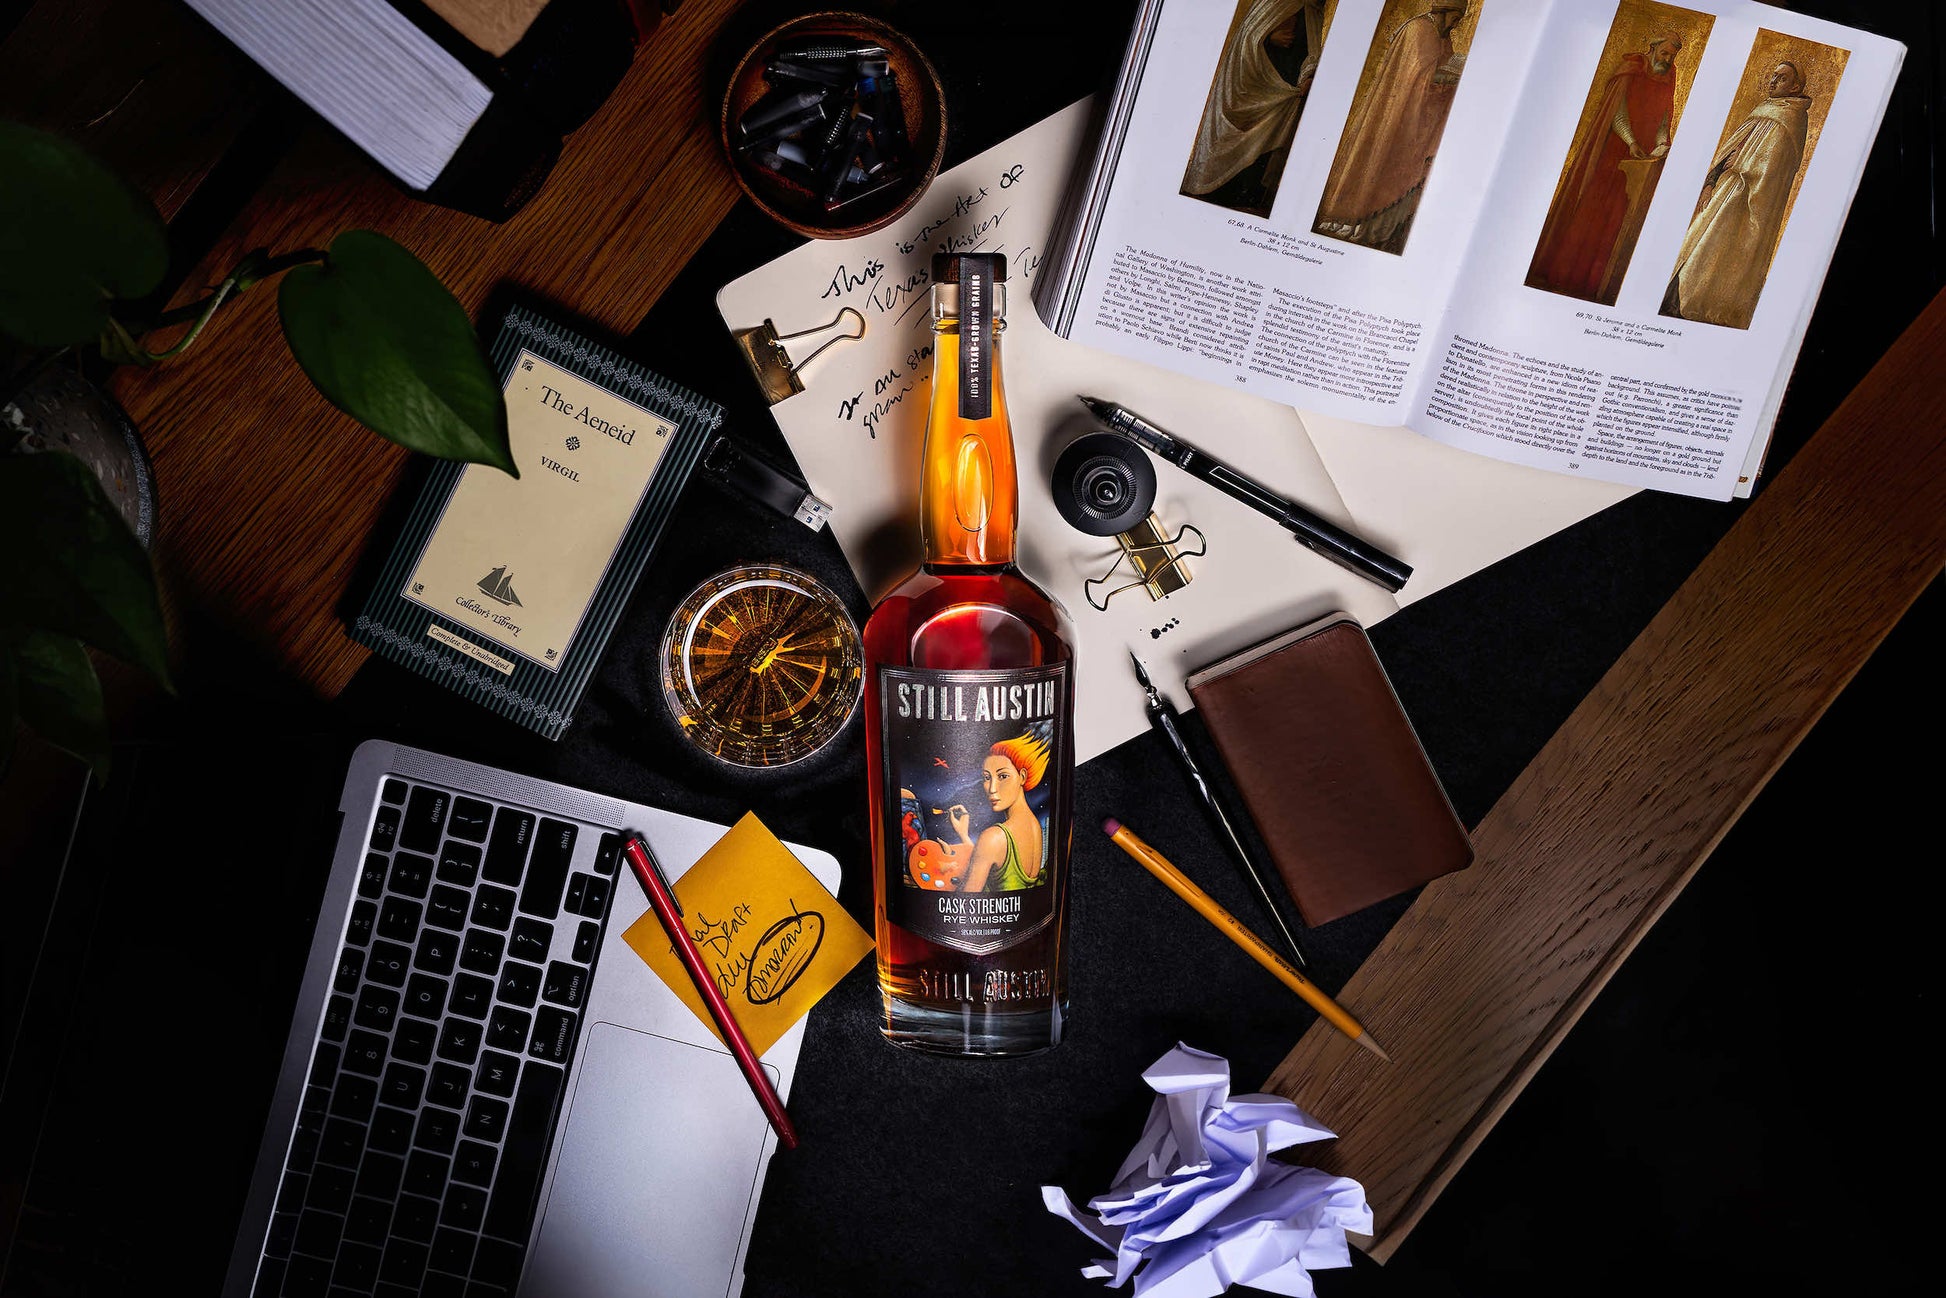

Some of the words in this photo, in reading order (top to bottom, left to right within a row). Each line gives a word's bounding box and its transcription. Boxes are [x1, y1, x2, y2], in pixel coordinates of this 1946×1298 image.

[896, 242, 914, 256] is
[1254, 226, 1280, 238] Carmelite
[1281, 234, 1296, 243] Monk
[1318, 244, 1345, 256] Augustine
[1115, 250, 1125, 258] nal
[1127, 254, 1148, 266] Gallery
[1159, 263, 1197, 279] Washington,
[1205, 278, 1229, 288] another
[1231, 285, 1247, 293] work
[1126, 245, 1137, 253] The
[1139, 249, 1168, 262] Madonna
[1179, 260, 1207, 274] Humility,
[1246, 280, 1265, 289] Natio-
[865, 268, 929, 312] Texas
[971, 274, 980, 307] GRAINS
[1112, 258, 1130, 268] buted
[1139, 265, 1166, 278] Masaccio
[1167, 273, 1175, 283] by
[1176, 276, 1207, 291] Berenson,
[1208, 285, 1234, 298] followed
[1235, 294, 1261, 307] amongst
[1378, 315, 1391, 324] Pisa
[1603, 317, 1623, 325] Jerome
[1641, 324, 1666, 334] Carmelite
[971, 312, 980, 373] TEXAS-GROWN
[1261, 325, 1274, 334] The
[1273, 330, 1307, 344] connection
[1325, 345, 1356, 357] polyptych
[1382, 357, 1410, 367] Florentine
[1453, 334, 1478, 347] throned
[1512, 352, 1524, 360] The
[1525, 357, 1546, 366] echoes
[1570, 367, 1586, 375] study
[1235, 375, 1246, 383] 388
[1465, 347, 1478, 356] and
[1477, 352, 1520, 369] contemporary
[1520, 364, 1548, 376] sculpture,
[1549, 370, 1564, 378] from
[1564, 373, 1582, 382] Nicola
[1582, 376, 1601, 385] Pisano
[970, 378, 979, 398] 100%
[540, 385, 573, 415] The
[574, 406, 636, 446] Aeneid
[1622, 417, 1641, 427] figures
[1641, 422, 1660, 431] appear
[1690, 430, 1714, 439] although
[1597, 429, 1615, 439] Space,
[1625, 436, 1659, 447] arrangement
[541, 456, 580, 482] VIRGIL
[1182, 452, 1193, 466] PILOT
[455, 596, 490, 618] Collector's
[491, 613, 522, 638] Library
[431, 627, 461, 646] Complete
[462, 642, 470, 650] &
[471, 647, 510, 670] Unabridged
[898, 682, 967, 721] STILL
[975, 680, 1055, 722] AUSTIN
[431, 798, 442, 823] delete
[517, 819, 528, 845] return
[561, 830, 570, 849] shift
[938, 897, 966, 914] CASK
[969, 896, 1021, 914] STRENGTH
[944, 915, 966, 924] RYE
[970, 914, 1020, 923] WHISKEY
[431, 948, 441, 958] P
[568, 975, 580, 1001] option
[919, 968, 974, 1001] STILL
[983, 969, 1050, 1004] AUSTIN
[378, 1006, 388, 1014] 9
[454, 1036, 466, 1046] K
[554, 1017, 569, 1056] command
[367, 1051, 377, 1060] 8
[492, 1069, 503, 1080] M
[480, 1114, 492, 1124] N
